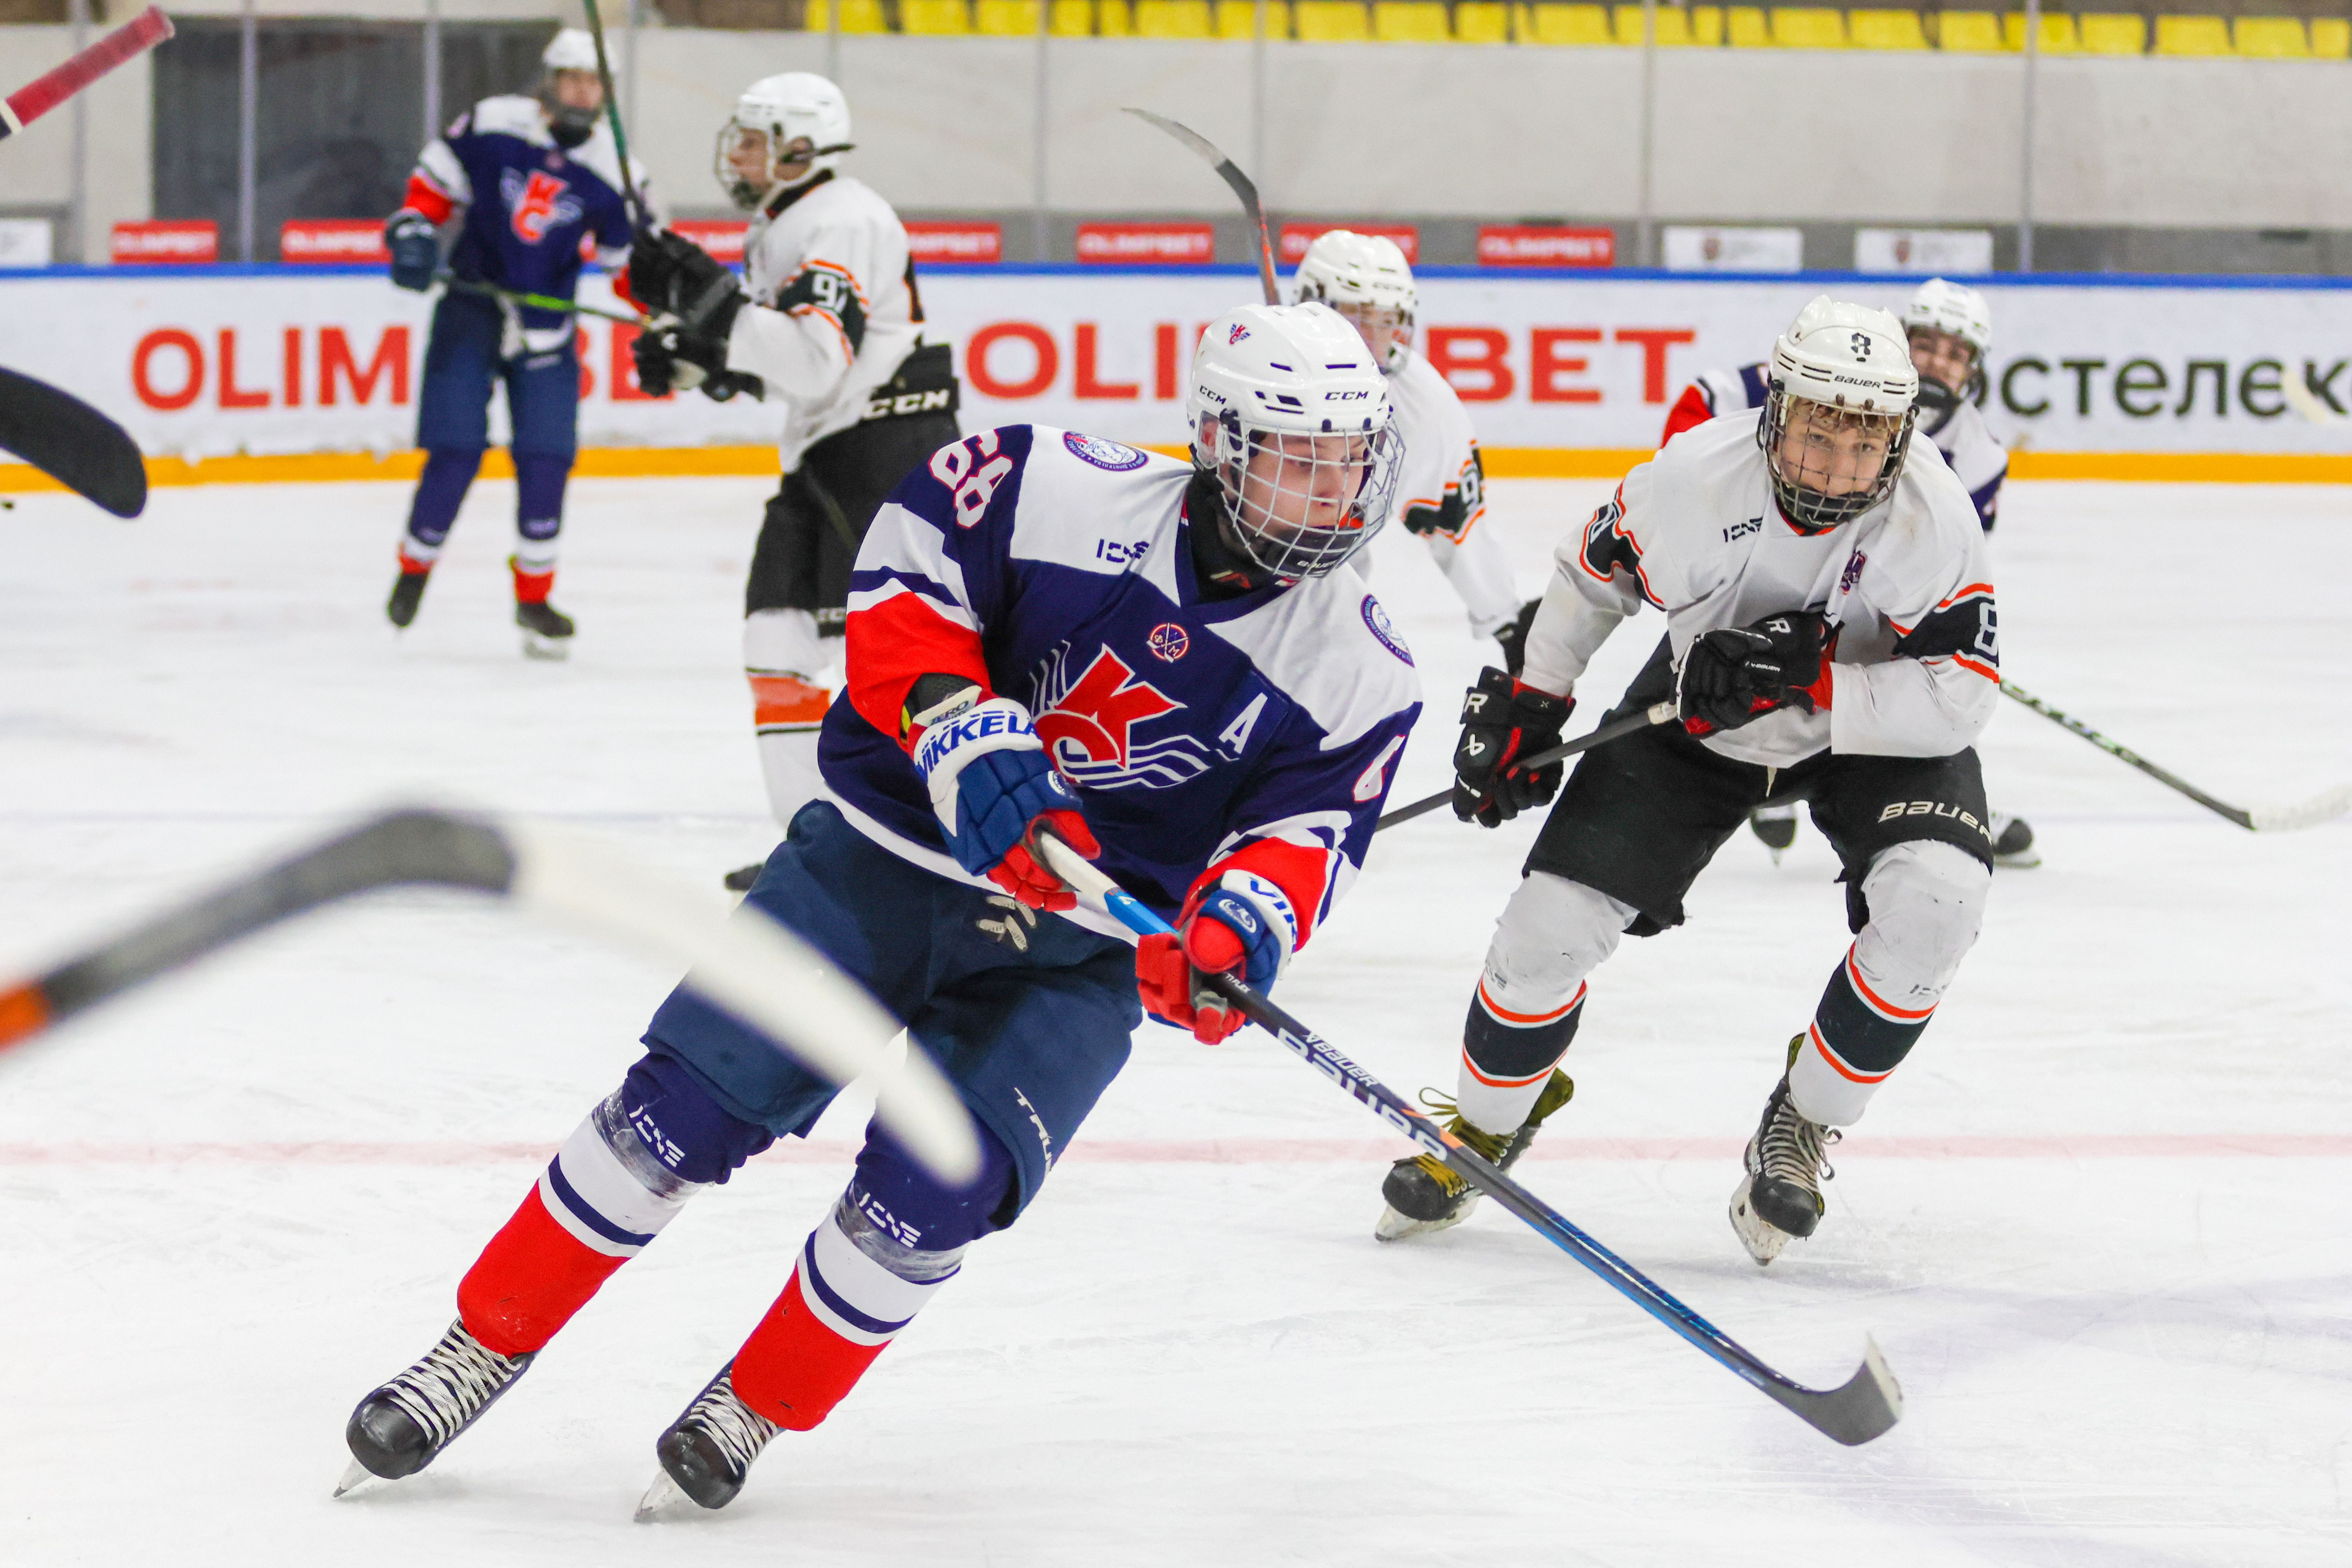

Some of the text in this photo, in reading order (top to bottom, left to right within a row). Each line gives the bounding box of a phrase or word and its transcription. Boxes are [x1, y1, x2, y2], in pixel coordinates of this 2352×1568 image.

[1834, 375, 1881, 388] BAUER
[862, 389, 950, 419] CCM
[1199, 384, 1227, 405] CCM
[1325, 391, 1370, 401] CCM
[1219, 692, 1268, 754] A
